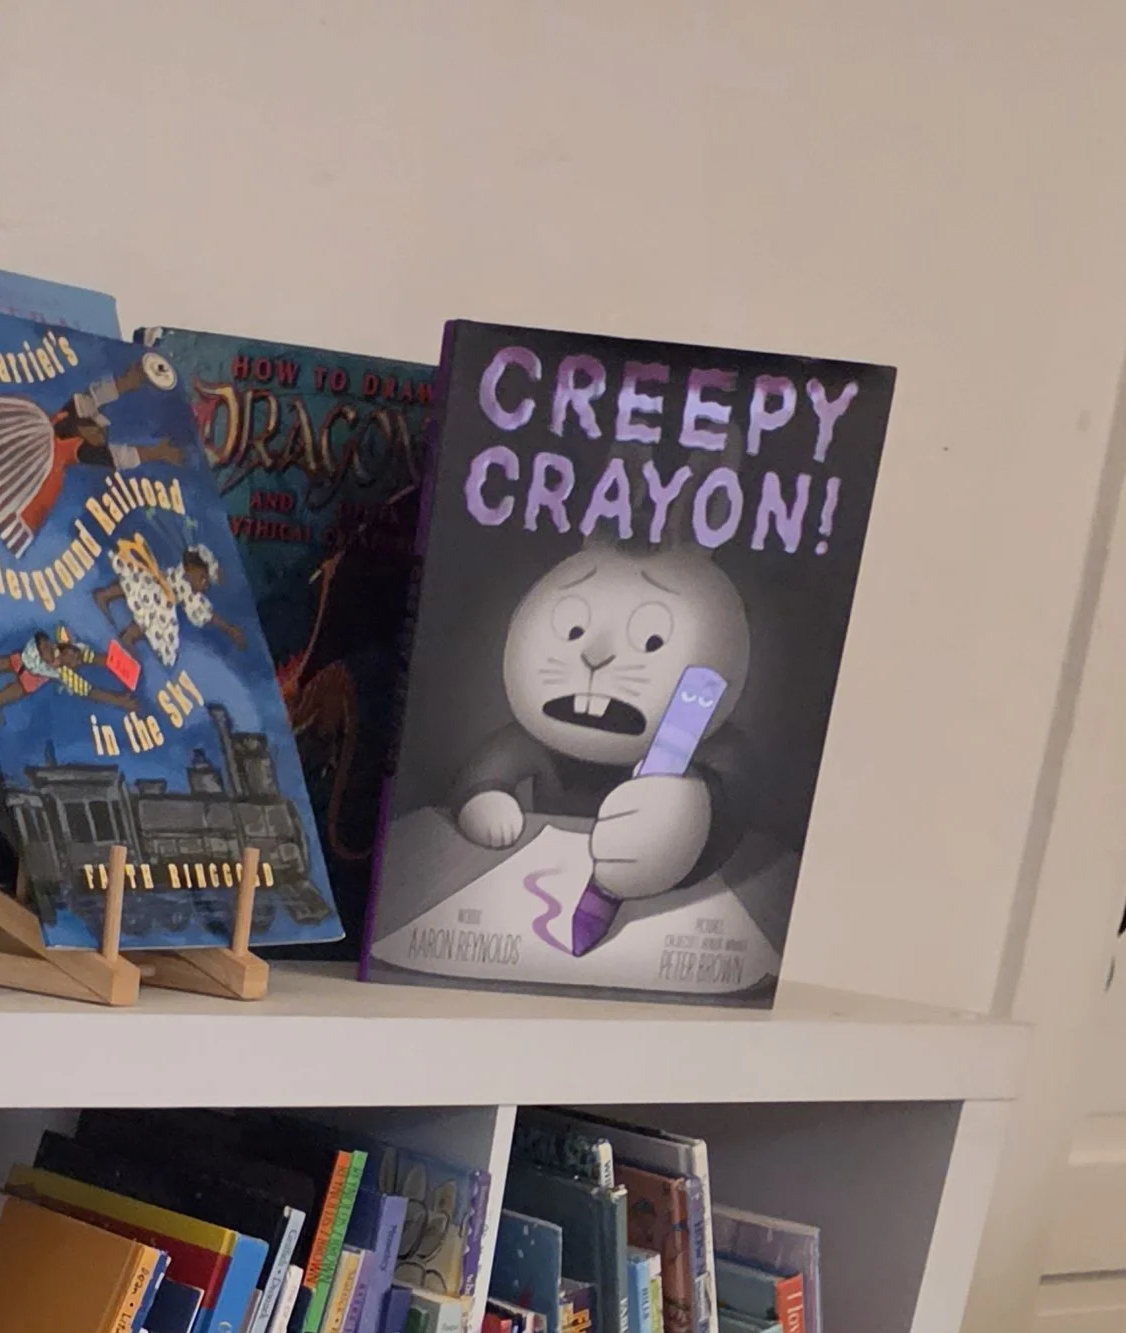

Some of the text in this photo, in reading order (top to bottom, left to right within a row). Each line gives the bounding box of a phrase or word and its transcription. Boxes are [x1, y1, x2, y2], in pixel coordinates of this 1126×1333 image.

[231, 356, 300, 387] HOW
[314, 367, 347, 390] TO
[478, 346, 859, 462] CREEPY
[85, 471, 185, 536] Railroad
[250, 491, 294, 513] AND
[465, 445, 841, 556] CRAYON!
[230, 517, 311, 542] YTHICAL
[91, 714, 119, 756] in
[124, 711, 165, 754] the
[83, 864, 155, 889] FATH
[408, 927, 522, 965] AARON REYNOLDS
